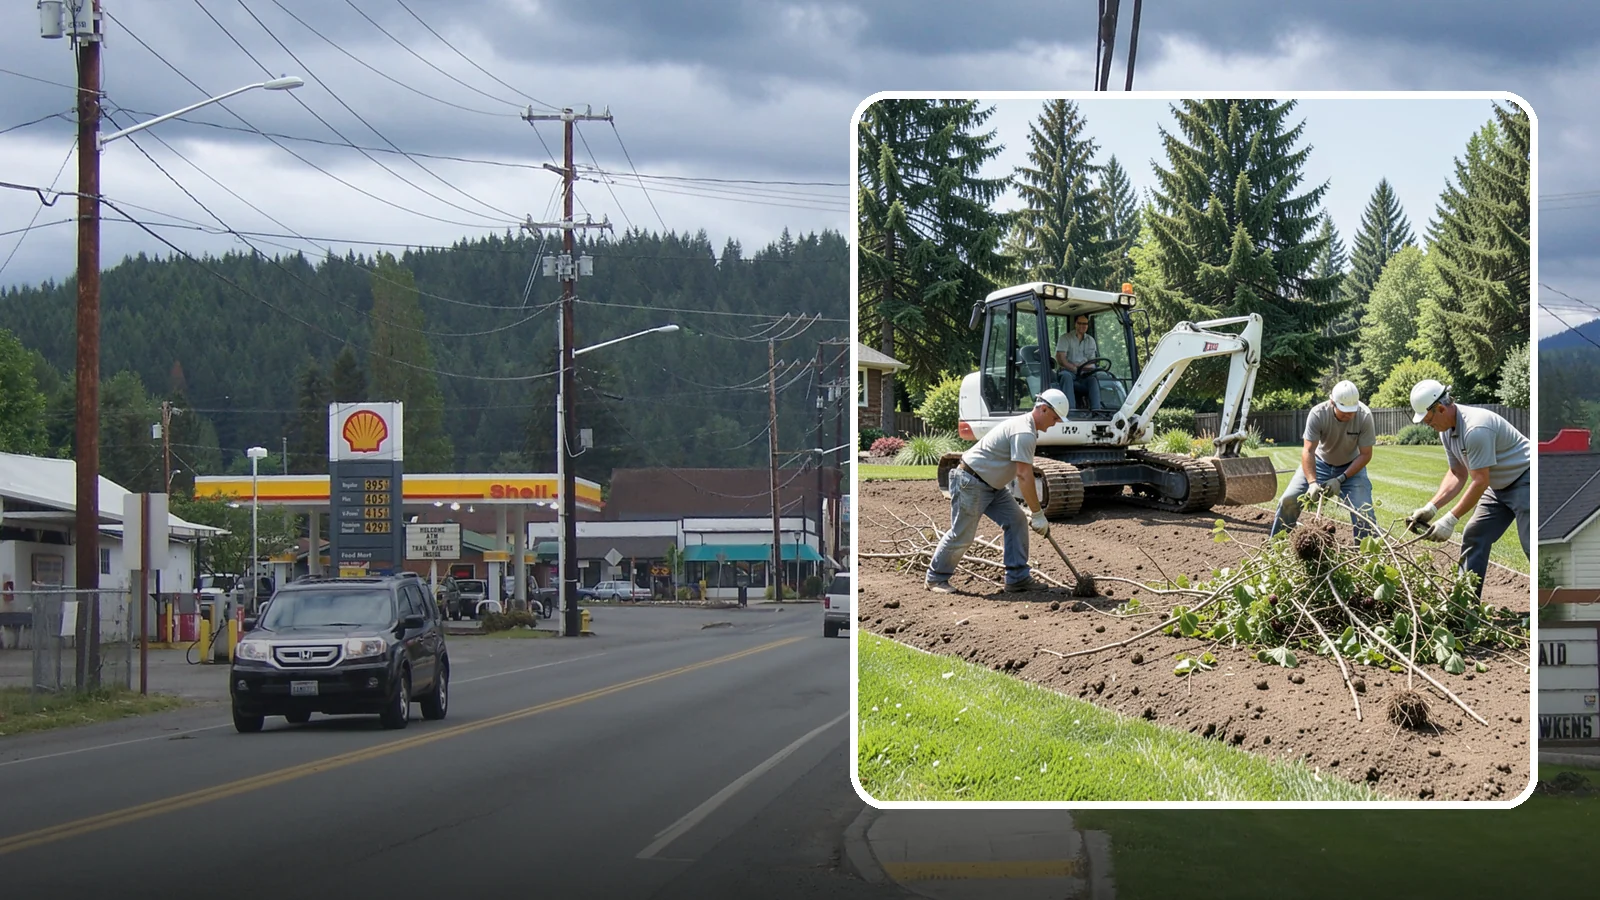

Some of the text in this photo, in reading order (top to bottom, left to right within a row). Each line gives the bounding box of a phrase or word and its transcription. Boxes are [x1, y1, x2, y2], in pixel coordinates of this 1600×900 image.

[366, 480, 383, 490] 395
[490, 484, 547, 499] Shell
[366, 494, 383, 504] 405
[366, 508, 383, 518] 415
[366, 522, 383, 533] 429
[1539, 642, 1567, 666] AID
